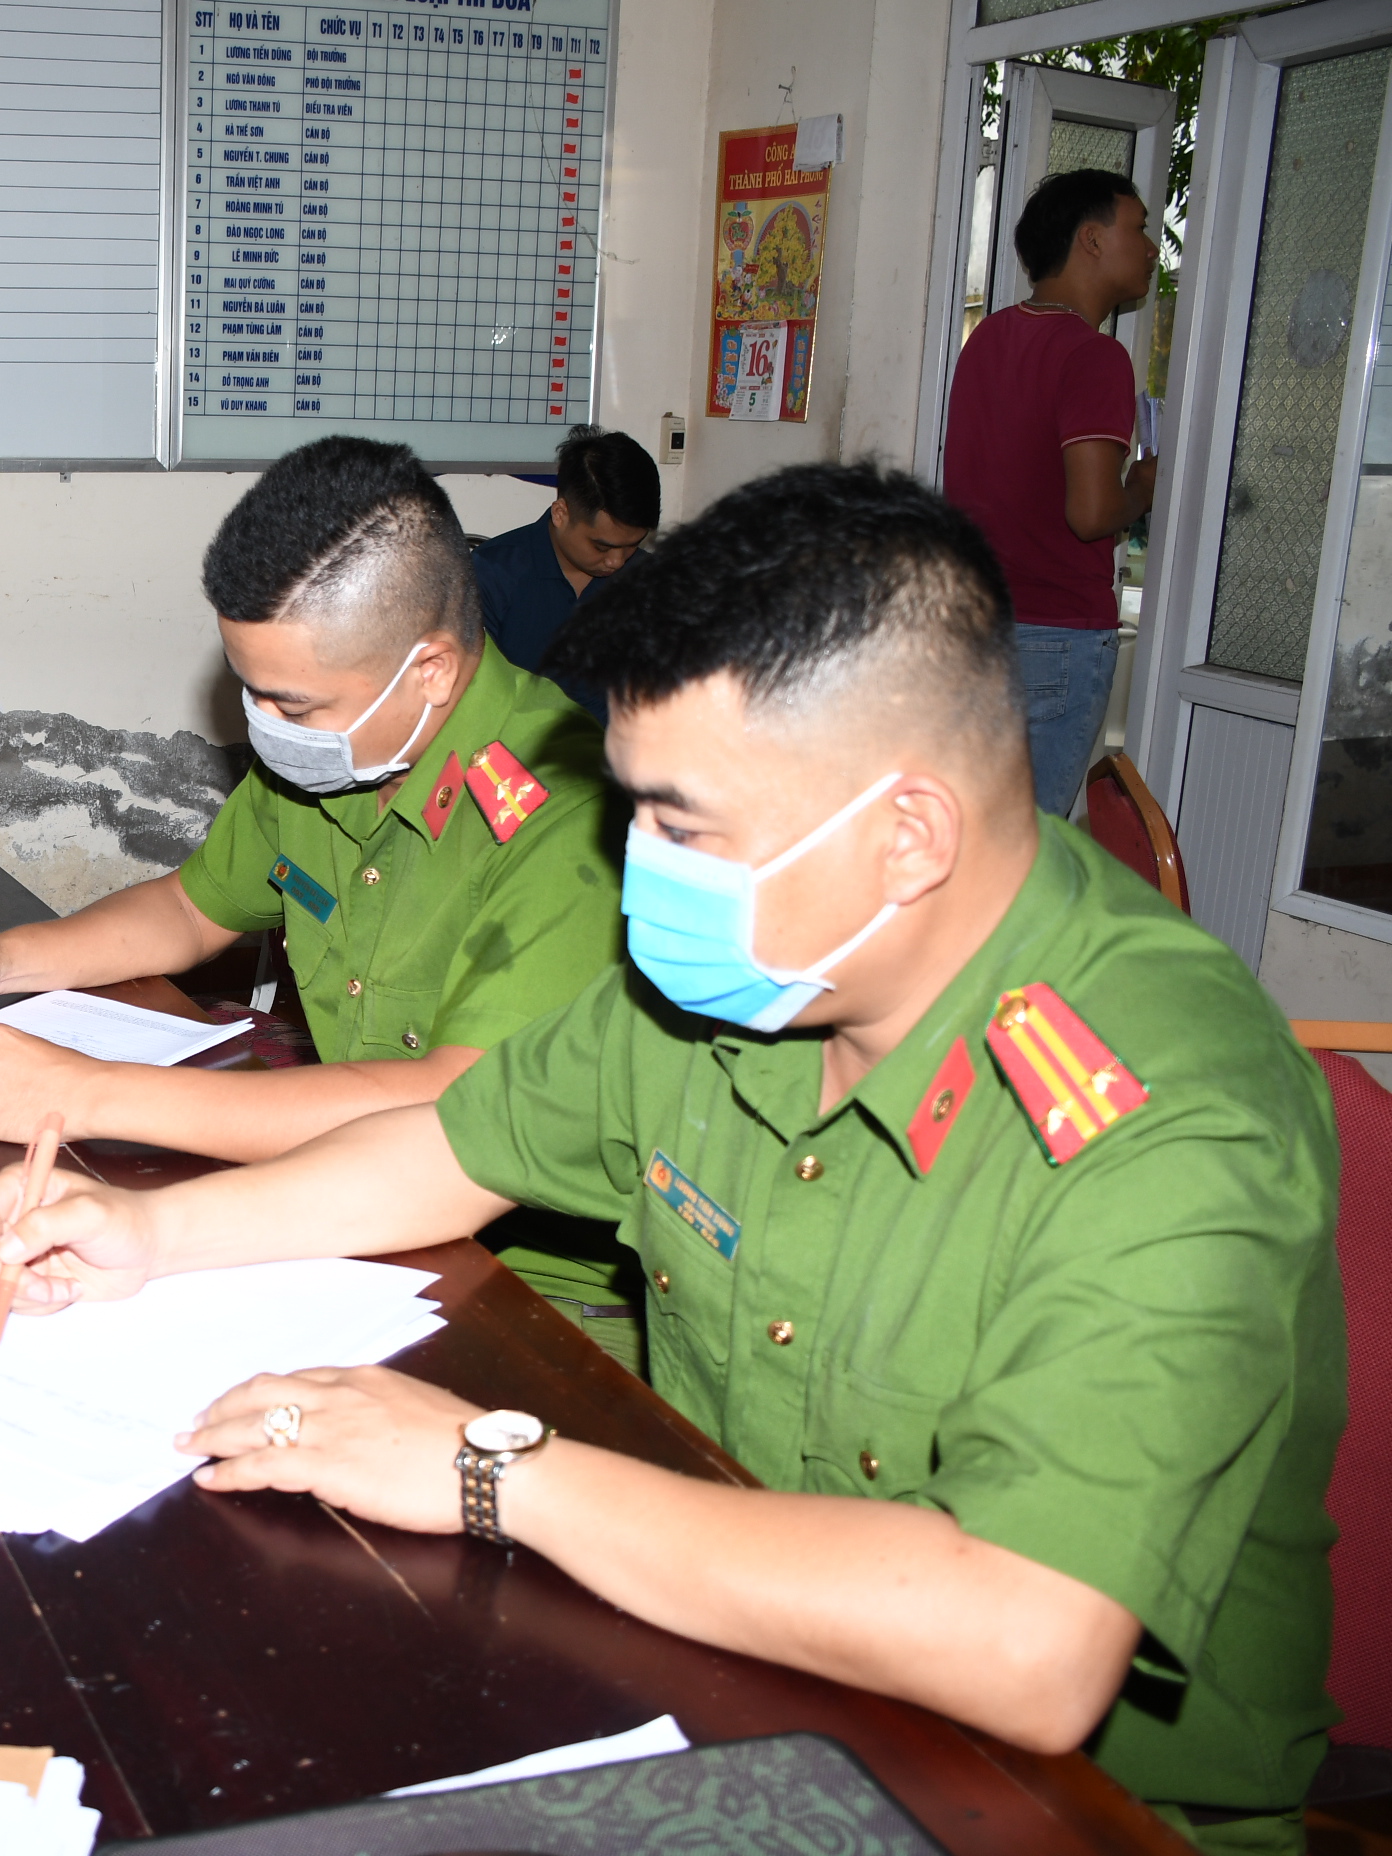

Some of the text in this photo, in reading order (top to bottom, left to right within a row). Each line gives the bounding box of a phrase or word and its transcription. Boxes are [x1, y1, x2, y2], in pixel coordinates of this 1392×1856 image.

[196, 11, 213, 28] STT
[230, 12, 242, 31] HỌ
[320, 15, 346, 36] CHỨC
[350, 21, 361, 39] VỤ
[372, 23, 382, 38] T1
[393, 24, 403, 39] T2
[414, 25, 424, 41] T3
[434, 28, 444, 43] T4
[453, 28, 463, 44] T5
[473, 30, 483, 46] T6
[493, 32, 504, 46] T7
[513, 33, 523, 48] T8
[532, 35, 541, 50] T9
[552, 37, 562, 52] T10
[571, 38, 580, 53] T11
[590, 39, 600, 55] T12
[200, 45, 204, 55] 1
[199, 71, 204, 81] 2
[197, 97, 202, 107] 3
[249, 101, 270, 112] THANH
[323, 104, 335, 115] TRA
[197, 123, 202, 132] 4
[197, 148, 202, 158] 5
[264, 152, 289, 163] CHUNG
[196, 174, 201, 184] 6
[265, 178, 280, 189] ANH
[765, 163, 783, 187] PHỐ
[196, 199, 201, 209] 7
[253, 202, 272, 214] MINH
[196, 225, 201, 234] 8
[266, 228, 284, 239] LONG
[194, 251, 199, 260] 9
[243, 251, 262, 262] MINH
[191, 274, 201, 284] 10
[224, 278, 236, 288] MAI
[190, 299, 200, 309] 11
[190, 323, 200, 333] 12
[190, 348, 200, 358] 13
[746, 340, 770, 376] 16
[189, 373, 199, 382] 14
[256, 377, 269, 387] ANH
[188, 397, 267, 411] 15 DUY KHANG
[749, 393, 756, 406] 5
